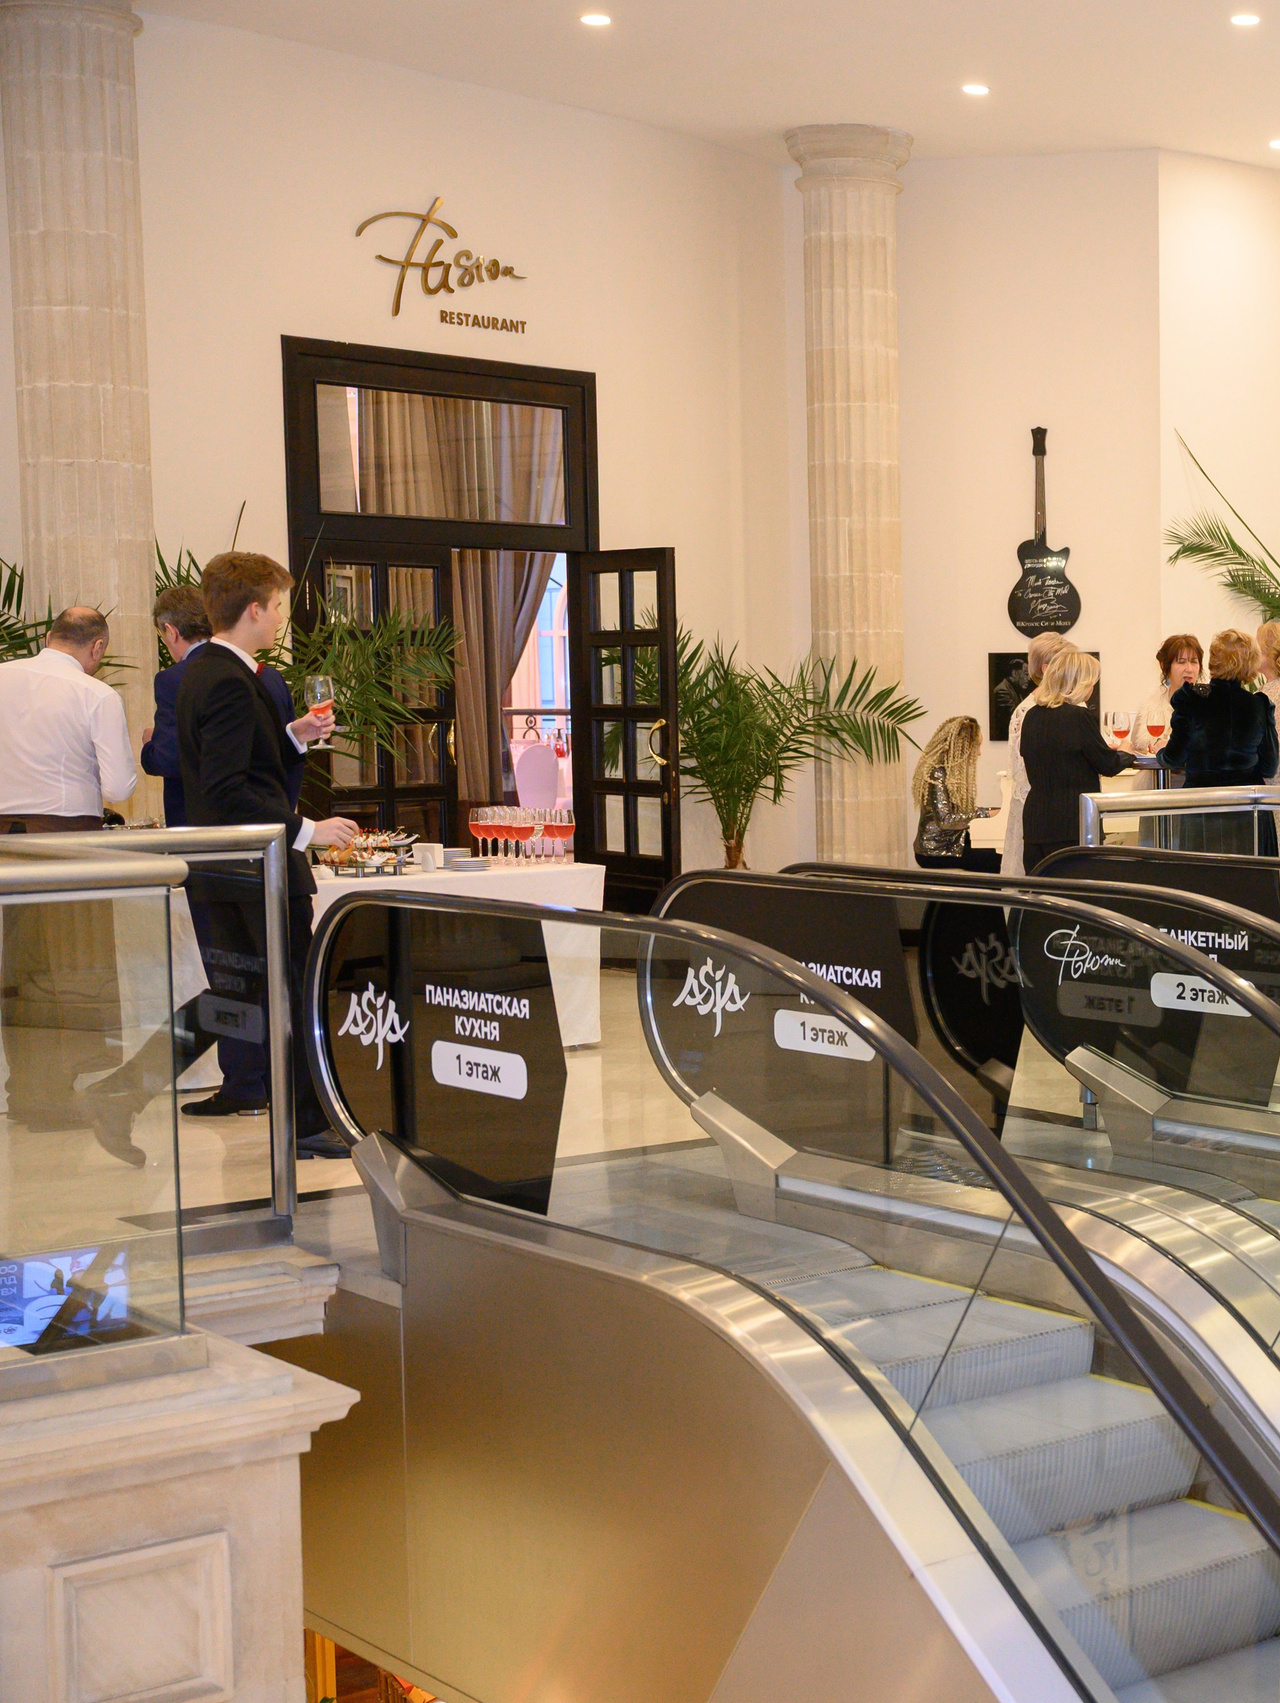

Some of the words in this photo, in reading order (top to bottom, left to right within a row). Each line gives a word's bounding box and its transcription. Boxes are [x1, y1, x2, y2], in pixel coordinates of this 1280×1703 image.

[355, 196, 527, 317] Fusion
[439, 309, 527, 334] RESTAURANT
[425, 984, 530, 1019] ПАНАЗИАТСКАЯ
[1176, 982, 1186, 1000] 2
[1190, 987, 1229, 1005] этаж
[454, 1014, 500, 1042] КУХНЯ
[800, 1020, 807, 1041] 1
[810, 1025, 849, 1047] этаж
[455, 1053, 462, 1076] 1
[465, 1060, 502, 1083] этаж
